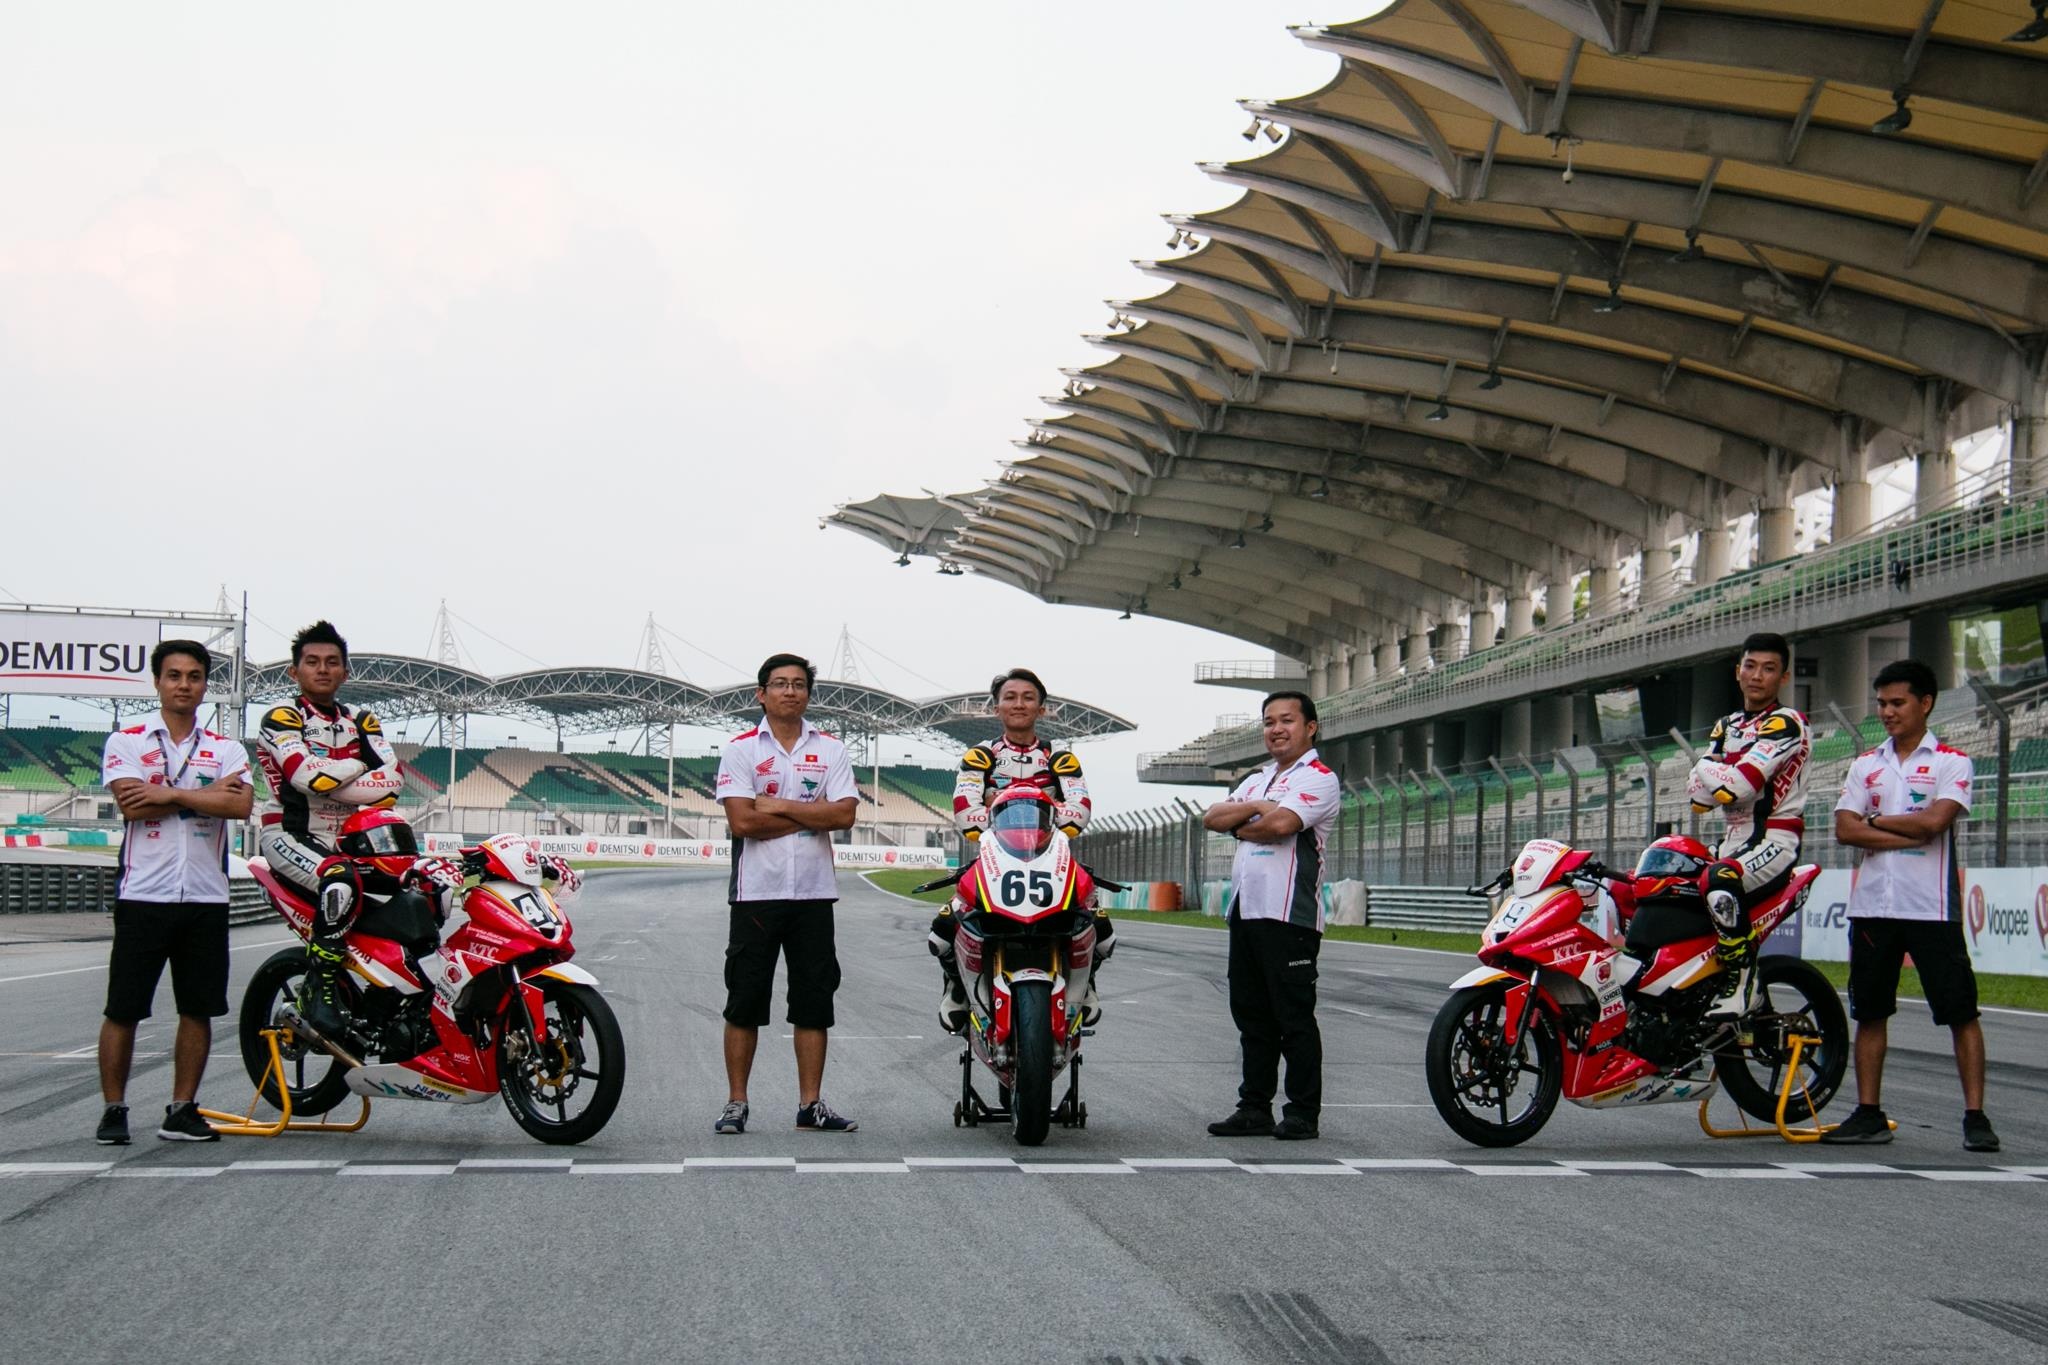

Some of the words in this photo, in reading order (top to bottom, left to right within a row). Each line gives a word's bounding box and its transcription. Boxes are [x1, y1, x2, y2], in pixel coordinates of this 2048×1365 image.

[355, 780, 402, 788] HONDA
[542, 843, 582, 854] IDEMITSU
[600, 845, 640, 855] IDEMITSU
[657, 846, 698, 856] IDEMITSU
[273, 838, 317, 873] TAICHI
[838, 851, 881, 862] IDEMITSU
[900, 854, 943, 864] IDEMITSU
[1001, 870, 1053, 908] 65
[1987, 904, 2029, 945] Voopee
[468, 941, 499, 960] KTC
[1552, 942, 1582, 961] KTC
[1602, 1001, 1624, 1016] RK
